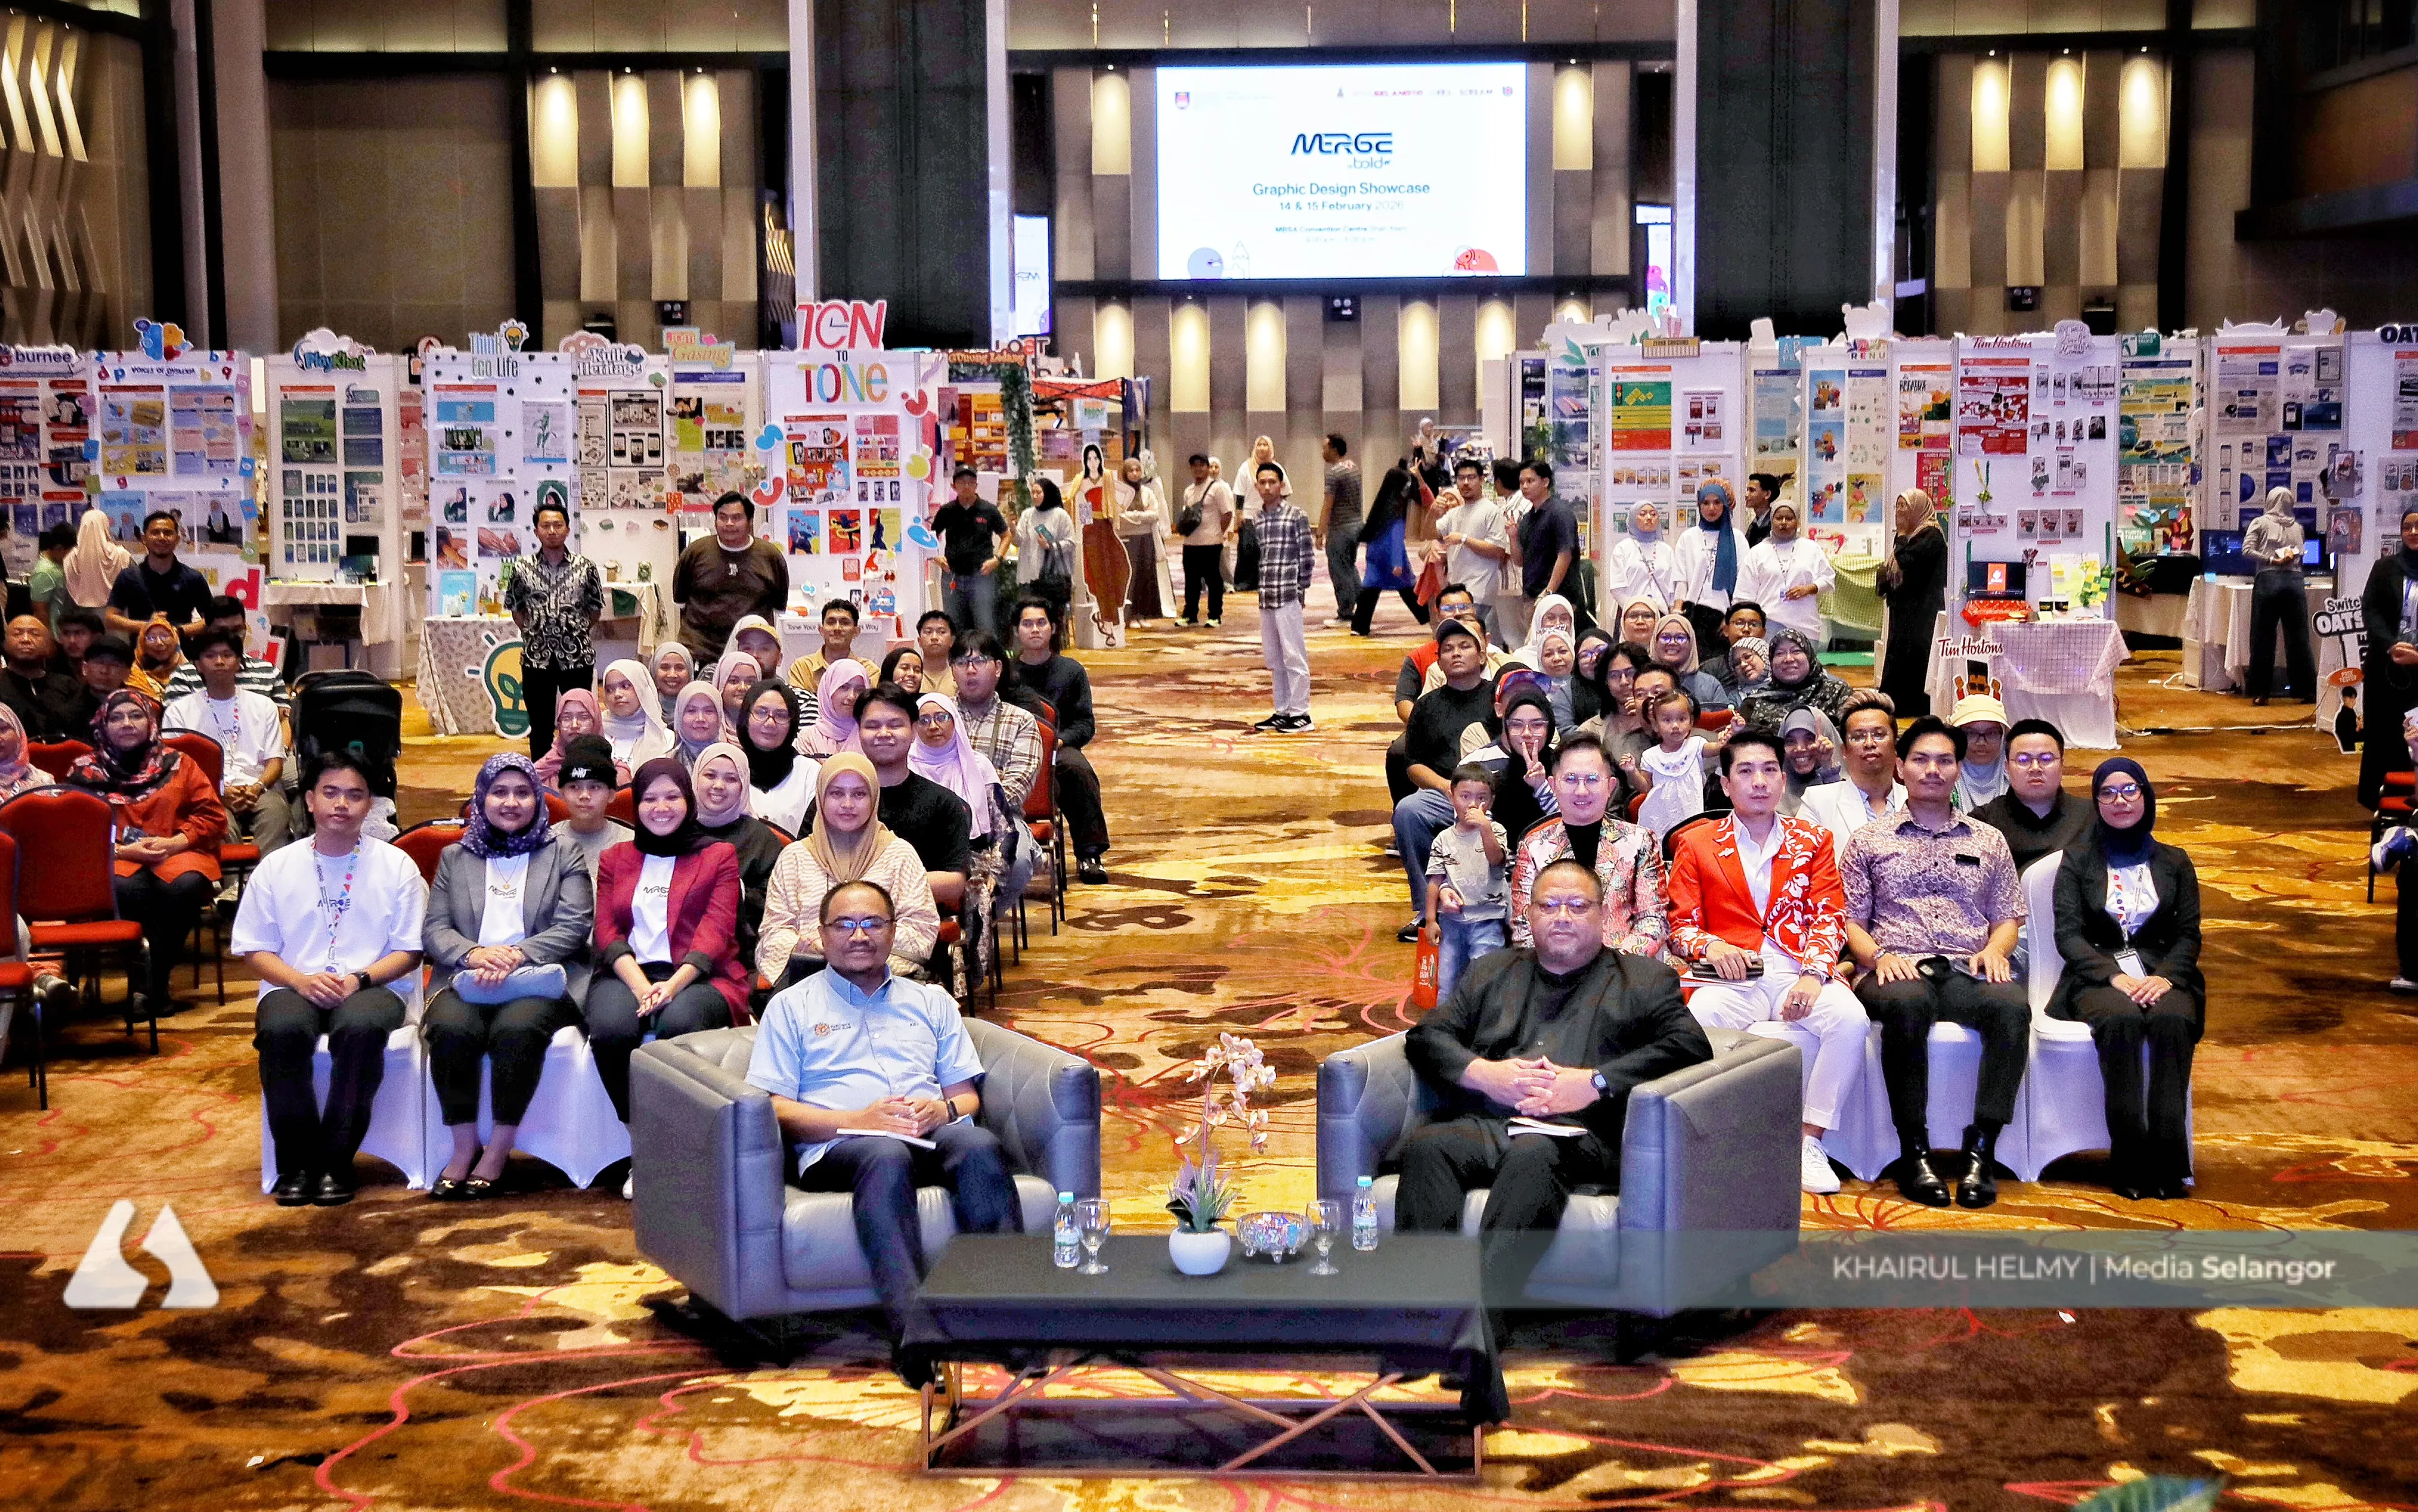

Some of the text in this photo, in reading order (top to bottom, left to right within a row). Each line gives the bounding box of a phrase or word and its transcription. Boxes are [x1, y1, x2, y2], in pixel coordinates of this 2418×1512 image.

[1291, 132, 1393, 155] MERGE
[1253, 182, 1430, 197] Graphic Design Showcase
[1280, 202, 1291, 210] 14
[1295, 201, 1303, 210] &
[1307, 201, 1318, 210] 15
[1321, 201, 1372, 212] February
[1973, 336, 2032, 349] Tim Hortons
[837, 350, 849, 362] TO
[2327, 597, 2363, 612] Switc
[1938, 636, 2004, 657] Tim Hortons
